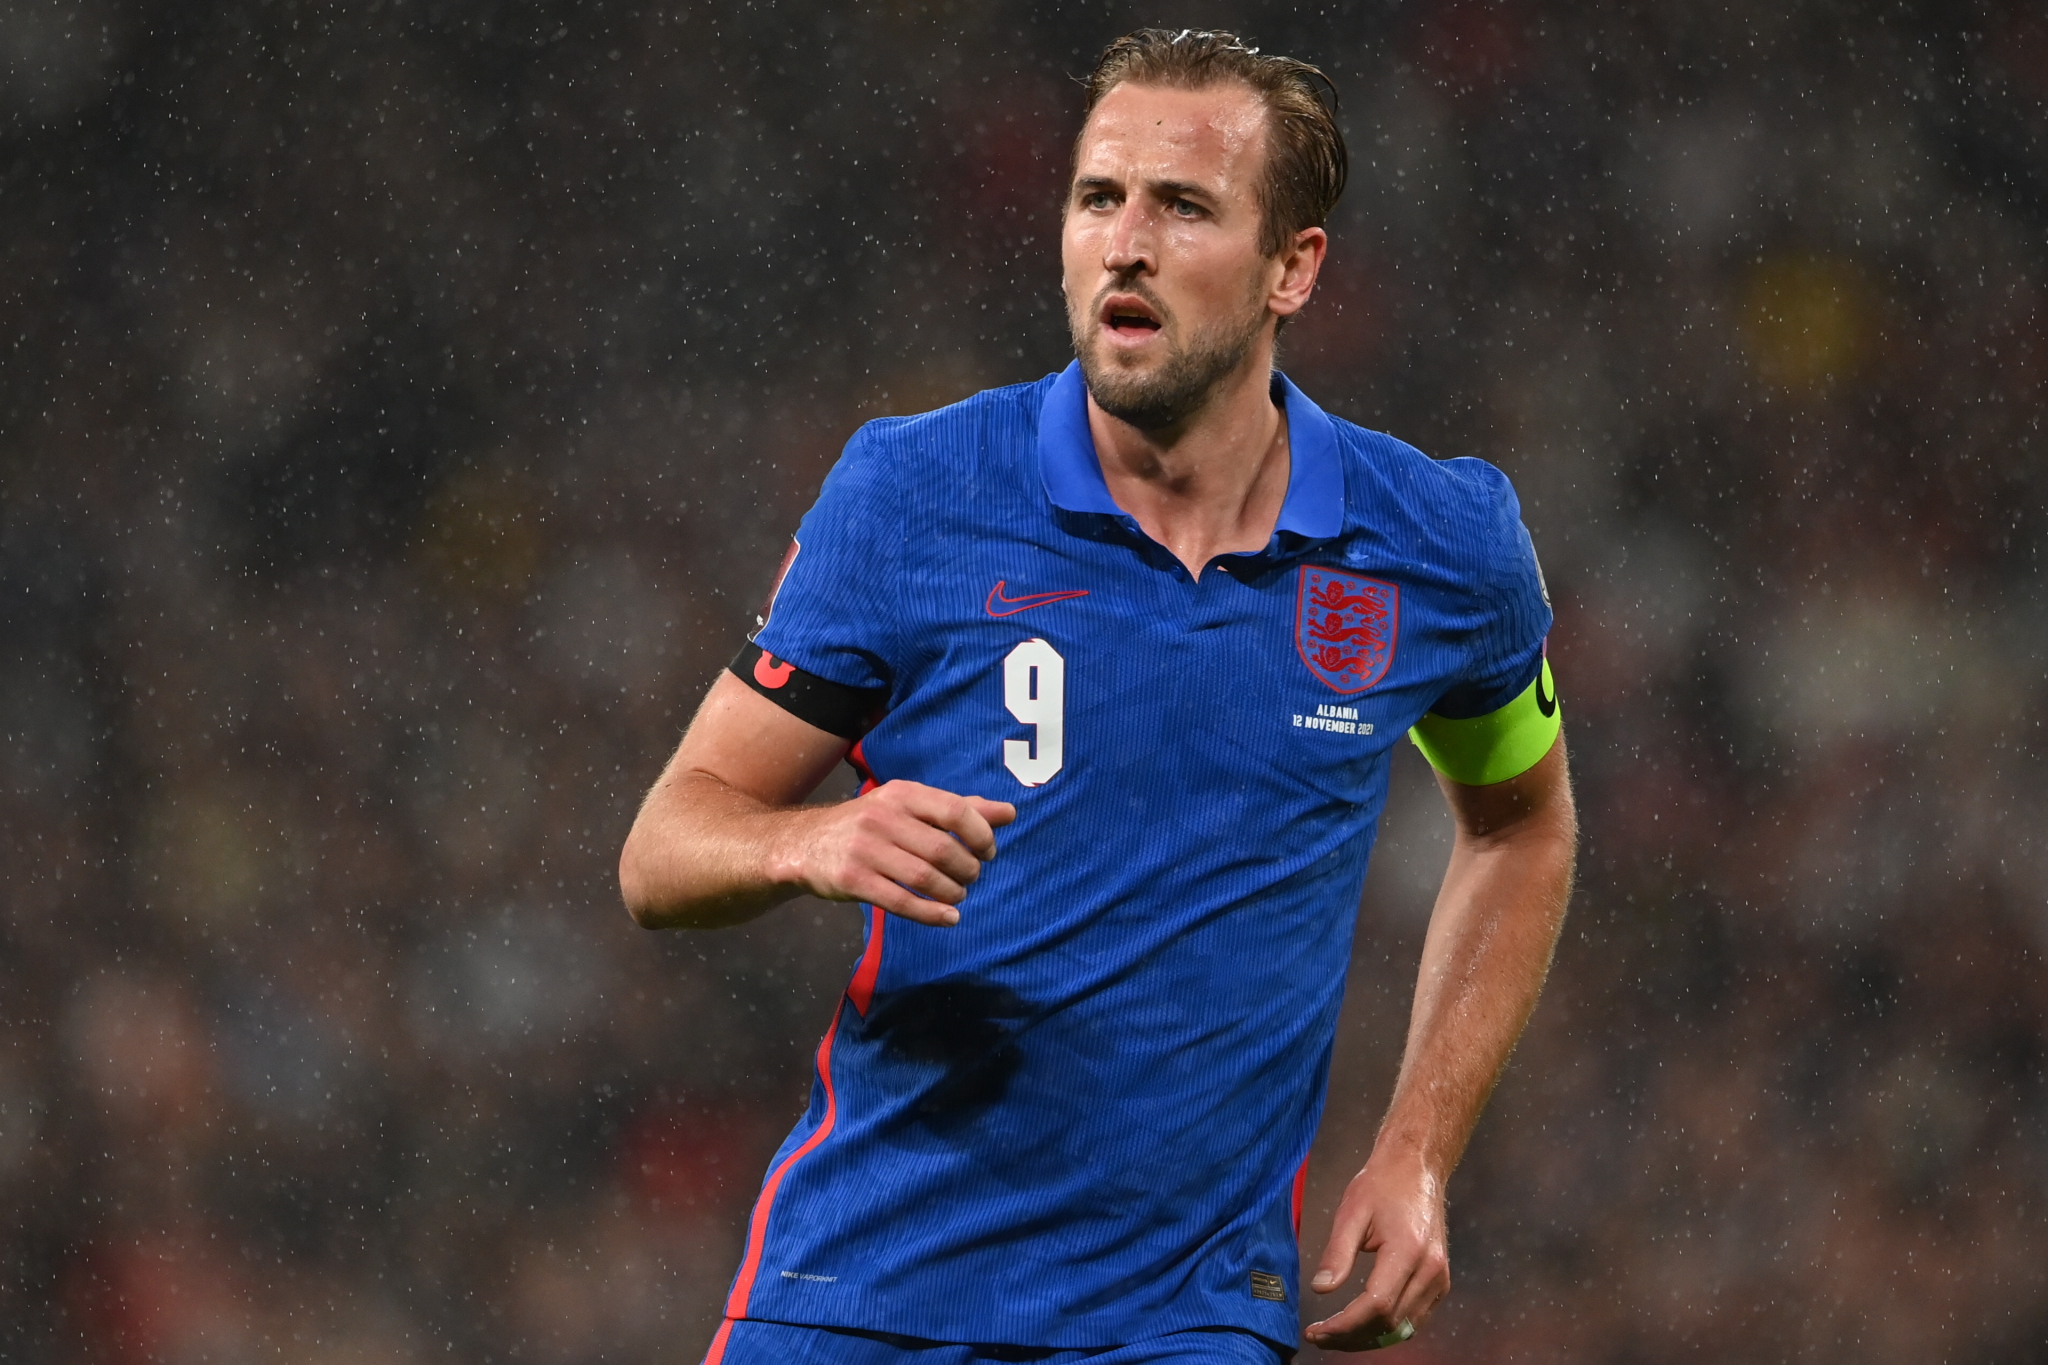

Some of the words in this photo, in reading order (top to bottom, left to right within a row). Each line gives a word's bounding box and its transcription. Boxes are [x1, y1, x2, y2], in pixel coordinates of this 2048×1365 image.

[1003, 637, 1065, 788] 9
[1316, 704, 1358, 720] ALBANIA
[1293, 714, 1302, 727] 12
[1305, 716, 1355, 734] NOVEMBER
[1357, 723, 1374, 735] 2021
[780, 1270, 799, 1279] NIKE
